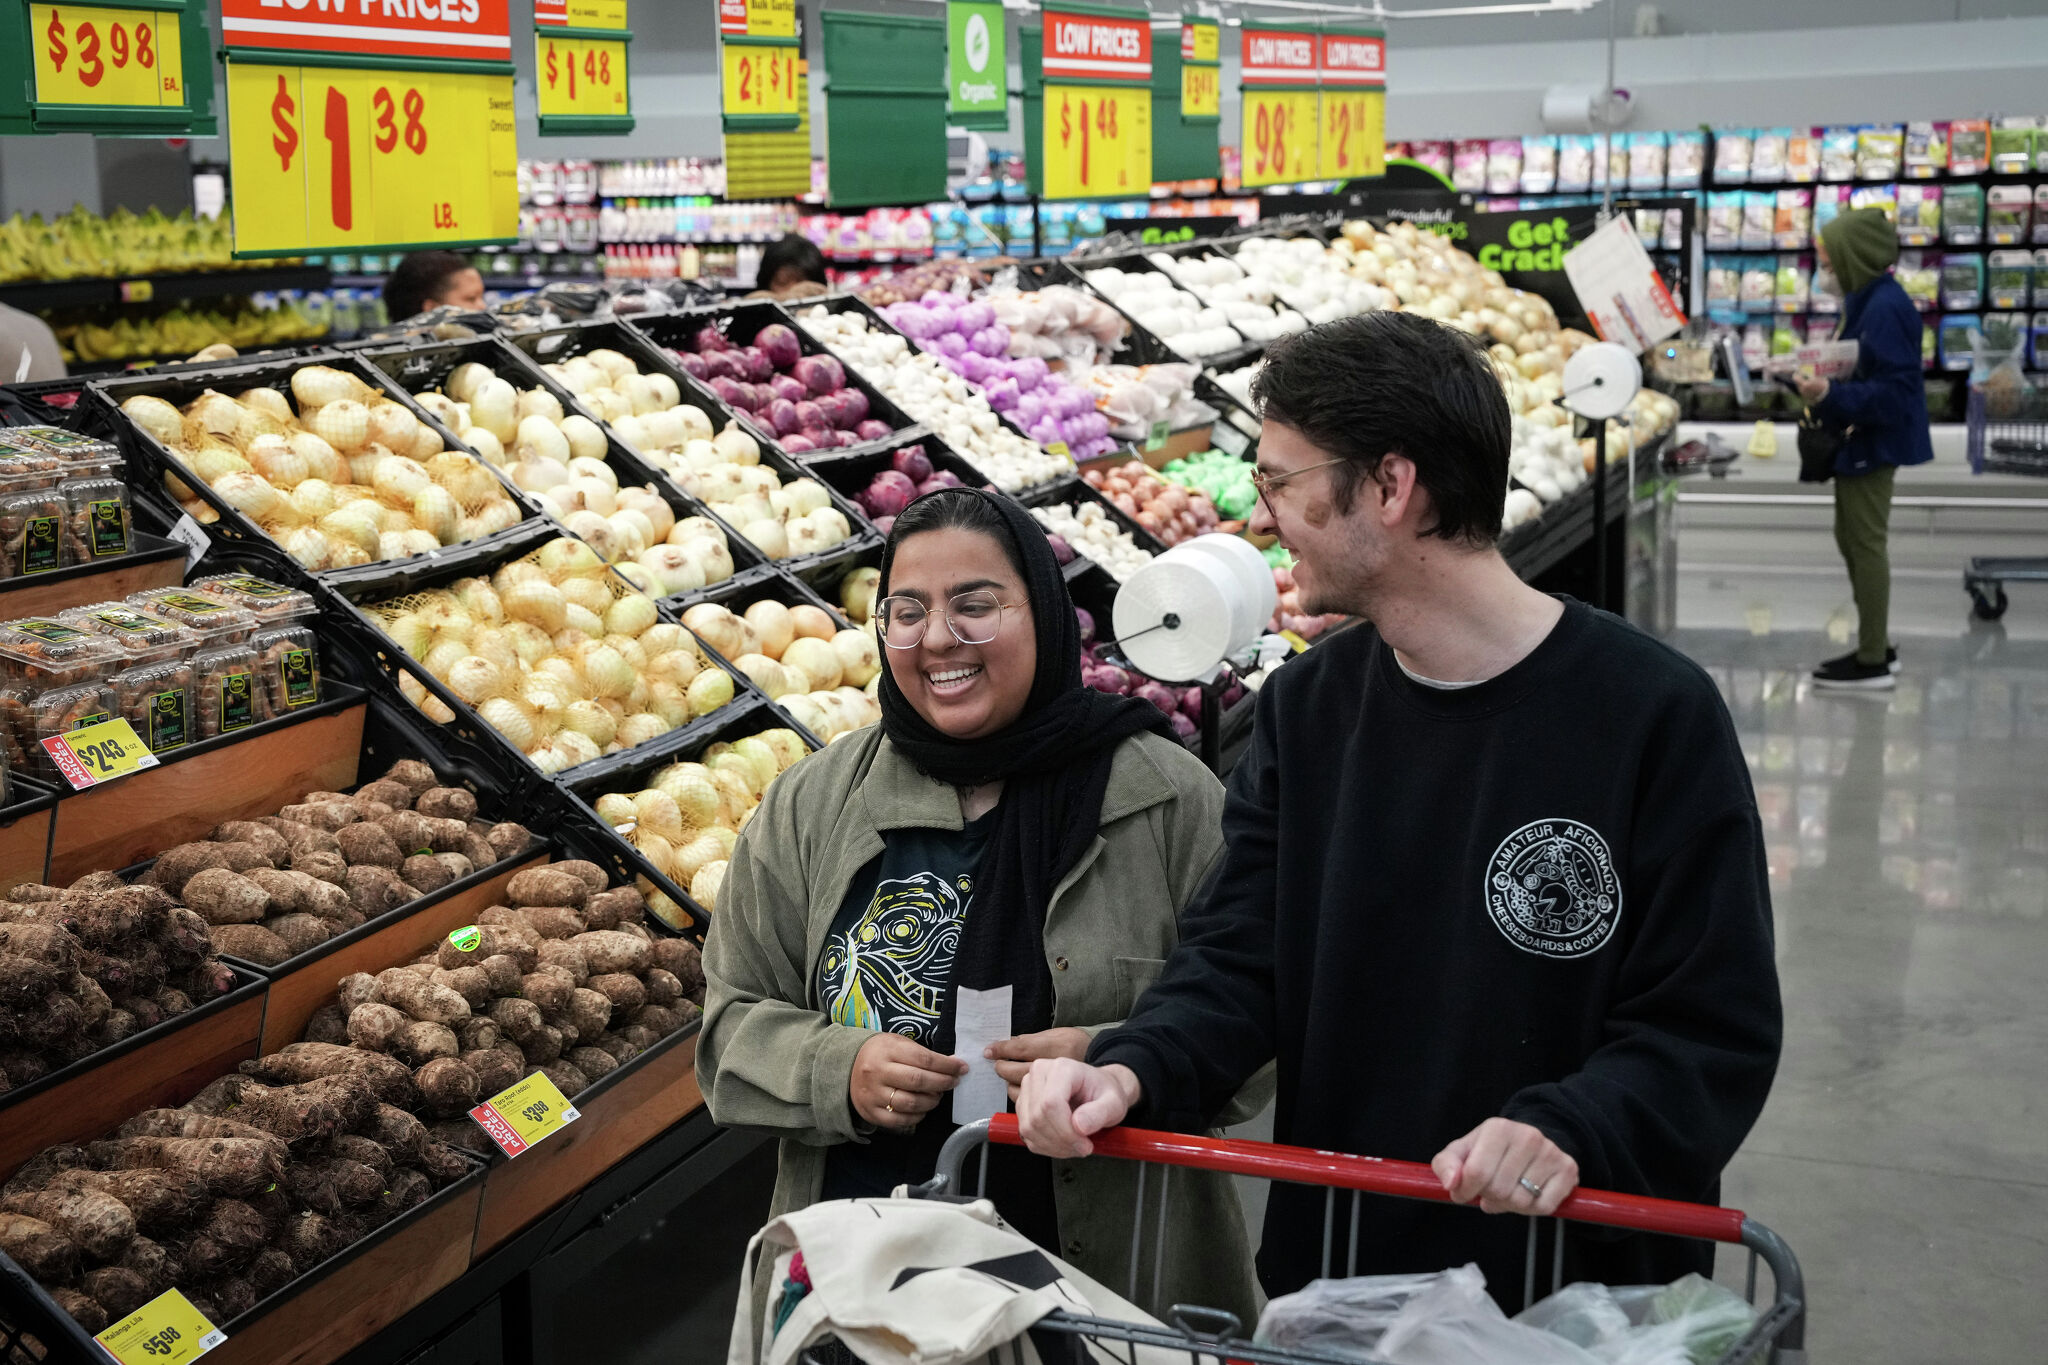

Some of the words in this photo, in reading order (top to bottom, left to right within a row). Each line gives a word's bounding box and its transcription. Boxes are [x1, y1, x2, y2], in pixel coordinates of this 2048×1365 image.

[48, 8, 154, 87] $398
[1055, 22, 1090, 54] LOW
[1091, 25, 1140, 58] PRICES
[1250, 38, 1274, 64] LOW
[1275, 39, 1311, 66] PRICES
[1327, 42, 1349, 67] LOW
[1349, 43, 1380, 68] PRICES
[547, 40, 610, 100] $148
[959, 80, 998, 104] Organic
[271, 74, 427, 231] $138
[1061, 91, 1118, 187] $148
[1507, 216, 1569, 249] Get
[52, 751, 76, 778] LOW
[55, 742, 89, 782] PRICES
[77, 739, 126, 772] $243
[1496, 824, 1554, 870] AMATEUR
[1563, 825, 1616, 894] AFICIONADO
[505, 1091, 516, 1101] Root
[522, 1100, 549, 1122] $398
[483, 1109, 521, 1148] PRICES
[483, 1120, 509, 1146] LOW
[103, 1324, 131, 1342] Malanga
[142, 1326, 181, 1355] $598
